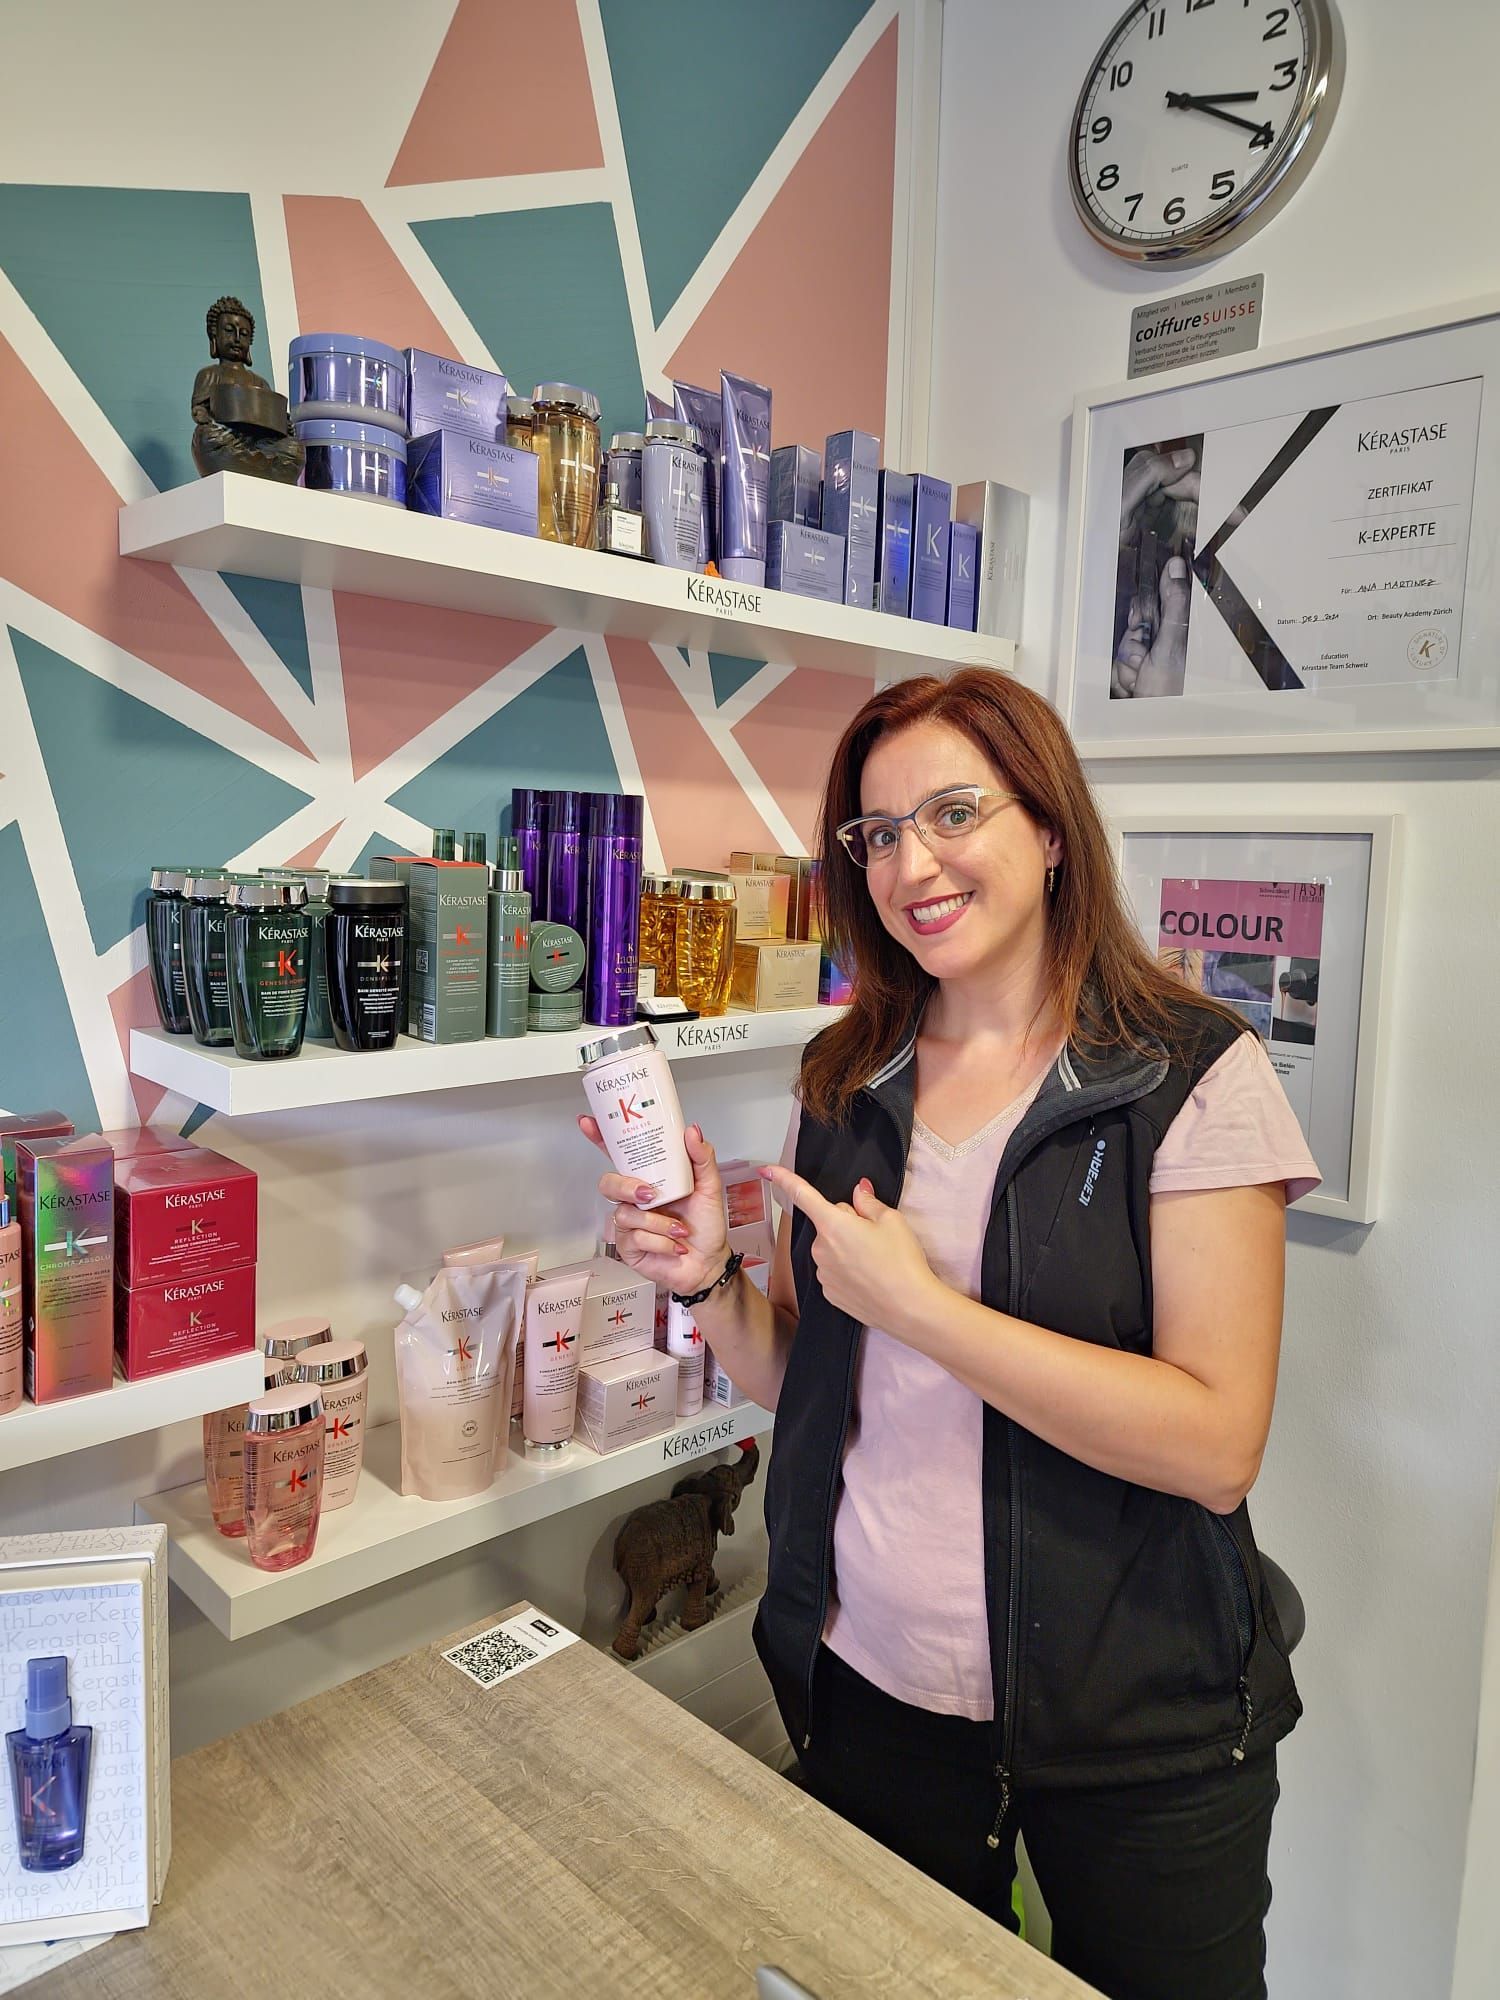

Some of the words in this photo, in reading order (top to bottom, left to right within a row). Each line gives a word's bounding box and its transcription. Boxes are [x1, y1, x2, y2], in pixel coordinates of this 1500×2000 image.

[1148, 9, 1166, 39] 11
[1262, 9, 1290, 41] 2
[1109, 61, 1133, 91] 10
[1269, 58, 1299, 90] 3
[1091, 117, 1112, 143] 9
[1249, 121, 1274, 149] 4
[1097, 164, 1120, 191] 8
[1209, 170, 1235, 200] 5
[1124, 193, 1144, 221] 7
[1163, 197, 1186, 225] 6
[1358, 422, 1448, 452] KÉRASTASE
[469, 440, 515, 463] KÉRASTASE
[1368, 480, 1433, 500] ZERTIFIKAT
[927, 523, 942, 558] K
[1358, 522, 1436, 544] K-EXPERTE
[687, 577, 761, 613] KÉRASTASE
[1358, 582, 1377, 593] ANA
[716, 607, 733, 616] PARIS
[1382, 612, 1402, 620] Beauty
[1404, 609, 1432, 618] Academy
[1433, 607, 1453, 616] Zürich
[1321, 652, 1349, 661] Education
[1345, 662, 1369, 670] Schweiz
[440, 894, 486, 906] KÉRASTASE
[259, 926, 309, 940] KÉRASTASE
[355, 924, 404, 938] KÉRASTASE
[1160, 910, 1284, 943] COLOUR
[542, 936, 573, 948] KÉRASTASE
[278, 949, 298, 977] K
[677, 1024, 749, 1047] KÉRASTASE
[596, 1067, 649, 1094] KÉRASTASE
[618, 1093, 643, 1123] K
[1079, 1150, 1104, 1206] ICEPEAK
[40, 1190, 111, 1210] KÉRASTASE
[165, 1188, 226, 1208] KÉRASTASE
[191, 1218, 204, 1235] K
[164, 1280, 224, 1303] KÉRASTASE
[602, 1291, 638, 1307] KÉRASTASE
[441, 1307, 484, 1323] KÉRASTASE
[538, 1297, 582, 1315] KÉRASTASE
[626, 1373, 661, 1392] KÉRASTASE
[663, 1419, 735, 1460] KÉRASTASE
[690, 1446, 707, 1457] PARIS
